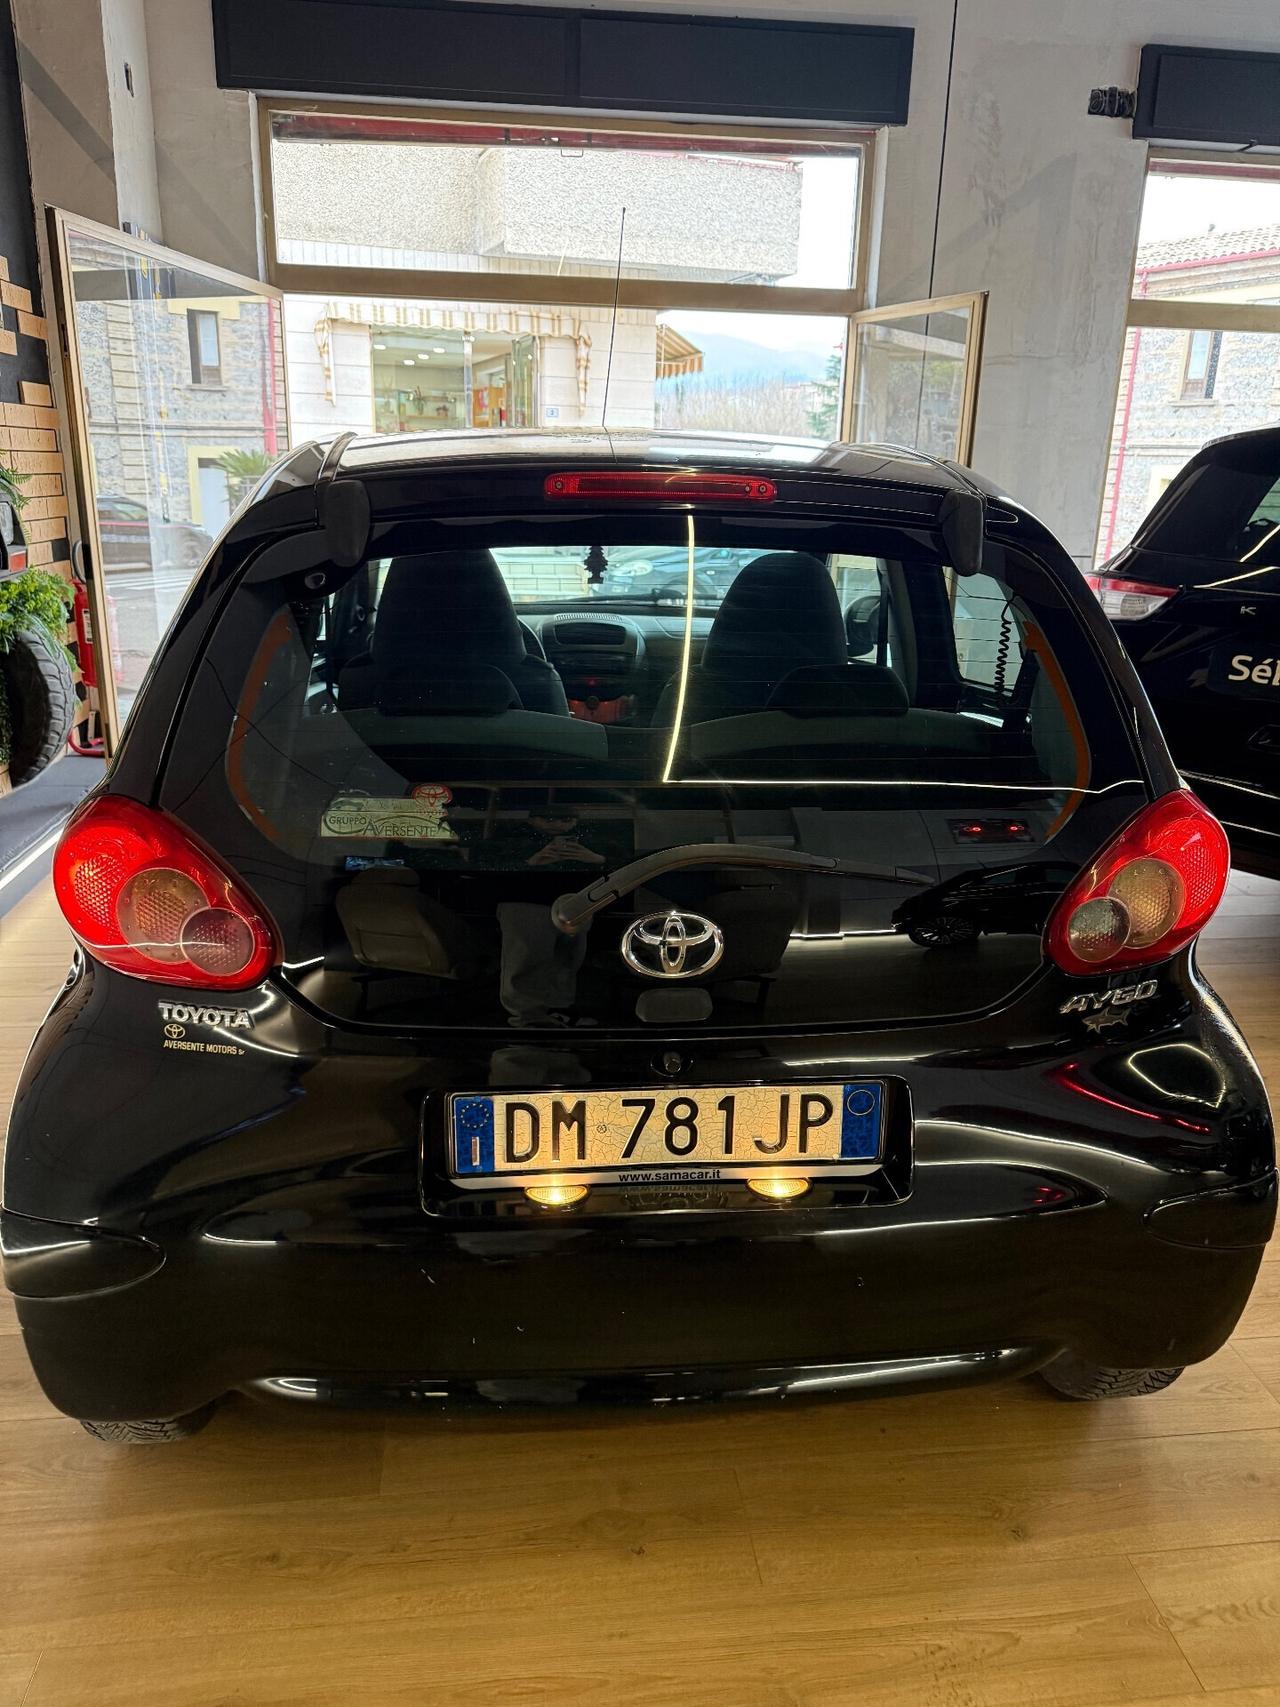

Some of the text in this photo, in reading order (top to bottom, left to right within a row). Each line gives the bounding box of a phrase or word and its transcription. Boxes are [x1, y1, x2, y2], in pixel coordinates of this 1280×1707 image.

[329, 816, 366, 825] GRUPPO
[1060, 980, 1157, 1014] AYGO
[158, 1002, 251, 1029] TOYOTA
[163, 1040, 205, 1052] AVERSENTE
[206, 1044, 237, 1055] MOTORS
[504, 1099, 587, 1164] DM
[618, 1169, 721, 1182] www.samacar.it
